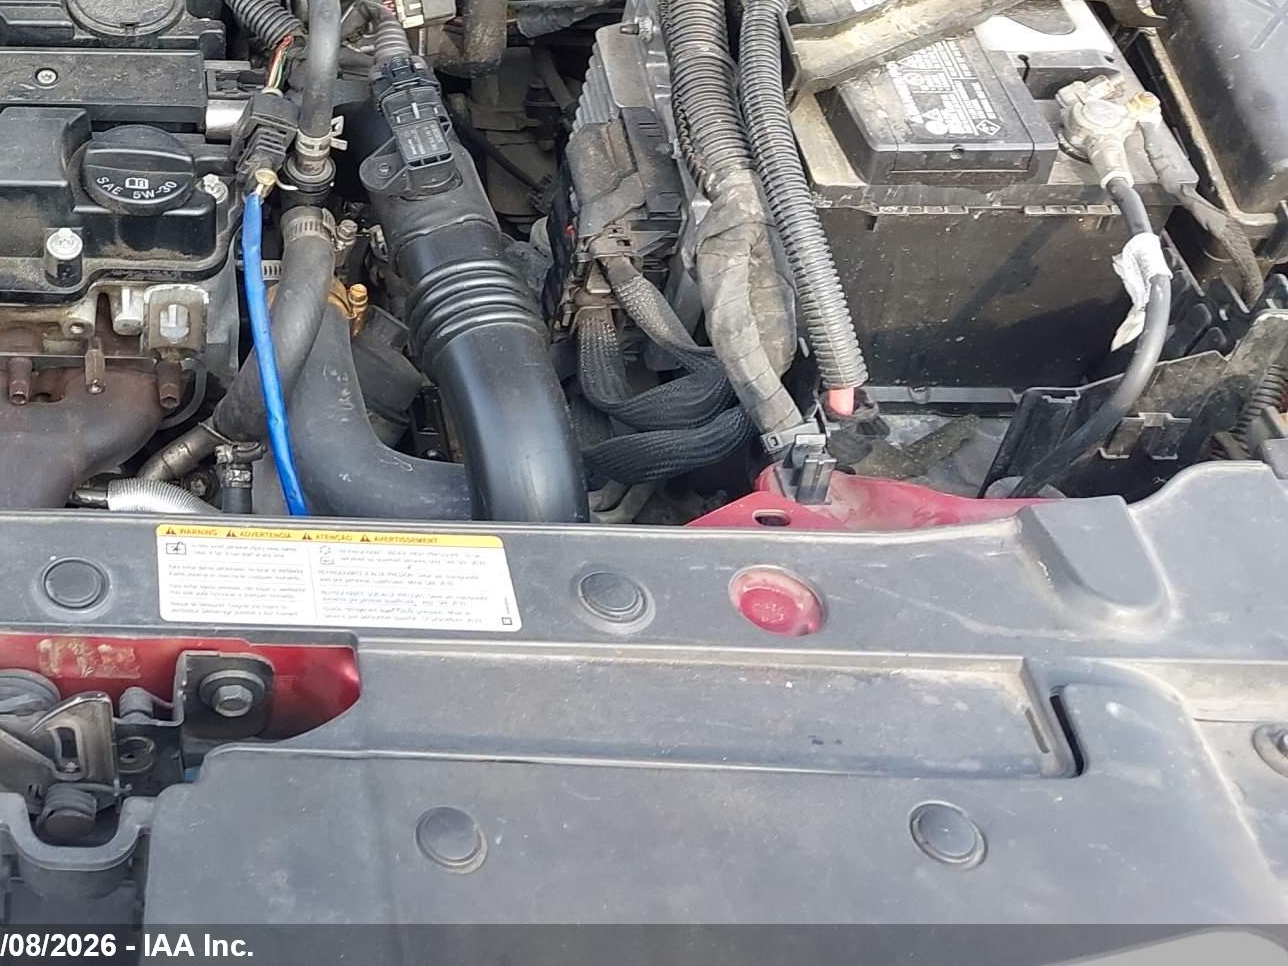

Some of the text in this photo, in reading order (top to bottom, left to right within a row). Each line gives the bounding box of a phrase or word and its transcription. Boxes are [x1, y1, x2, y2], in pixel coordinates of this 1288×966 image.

[96, 177, 178, 199] SAE 5W-30
[179, 528, 218, 536] WARNING
[239, 532, 292, 540] ADVERTENCIA
